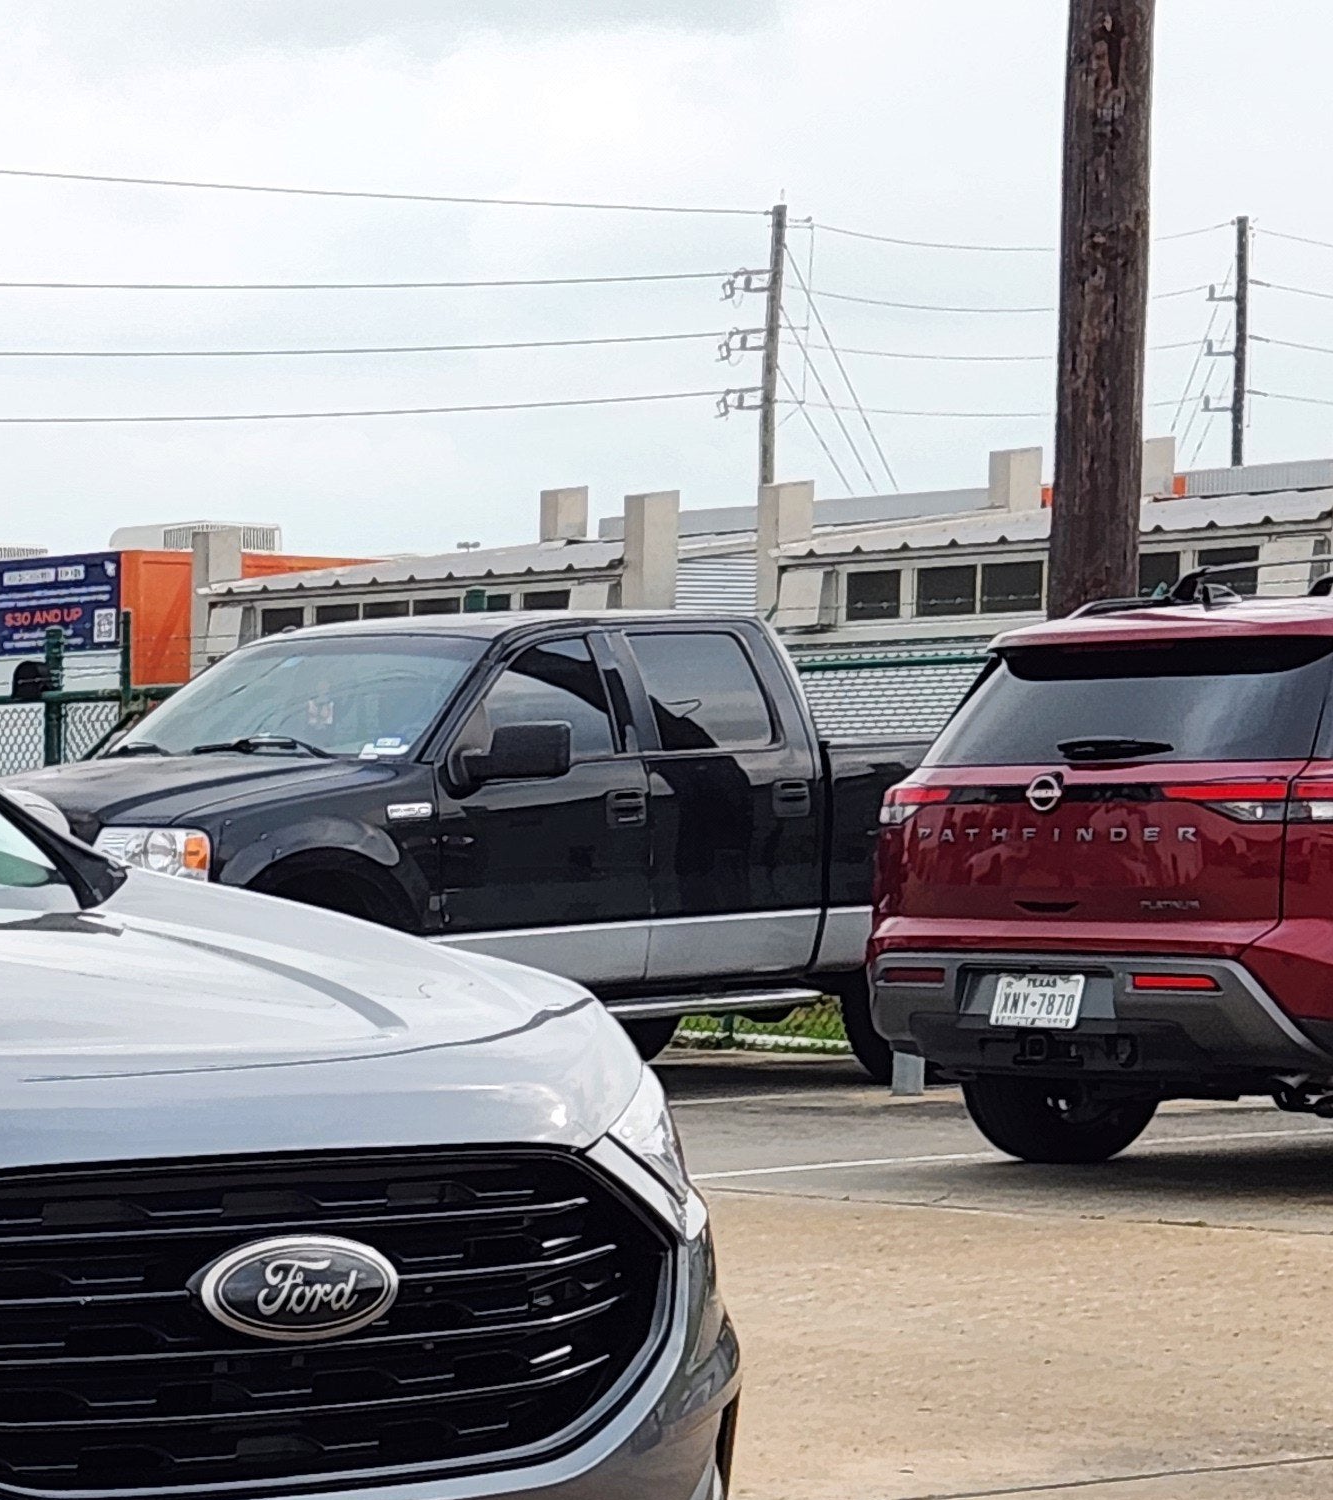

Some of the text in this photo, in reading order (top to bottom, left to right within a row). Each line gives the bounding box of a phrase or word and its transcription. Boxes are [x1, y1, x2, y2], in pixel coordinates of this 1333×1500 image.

[4, 607, 83, 627] $30 AND UP
[917, 826, 1198, 843] PATHFINDER
[256, 1257, 360, 1317] Ford
